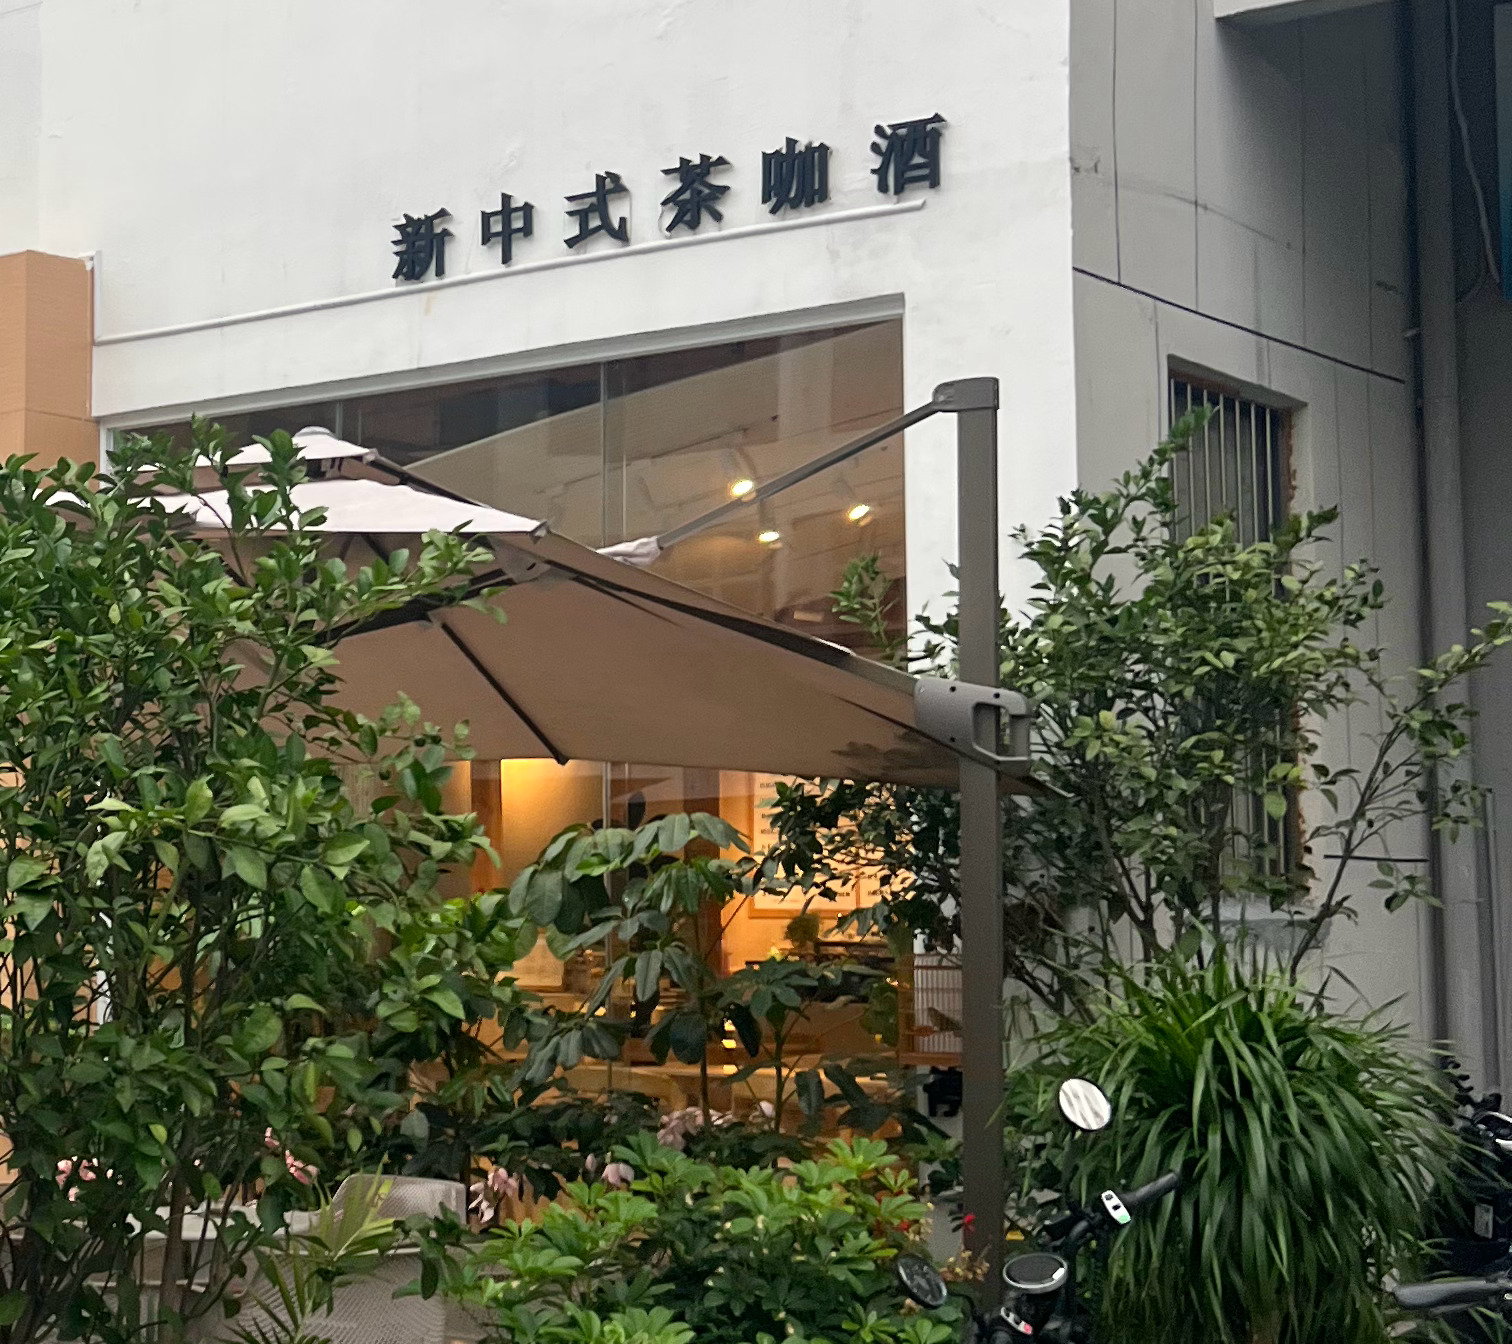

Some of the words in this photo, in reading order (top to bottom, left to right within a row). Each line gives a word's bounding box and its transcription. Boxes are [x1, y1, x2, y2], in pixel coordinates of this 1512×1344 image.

[392, 113, 947, 281] 新中式茶咖酒
